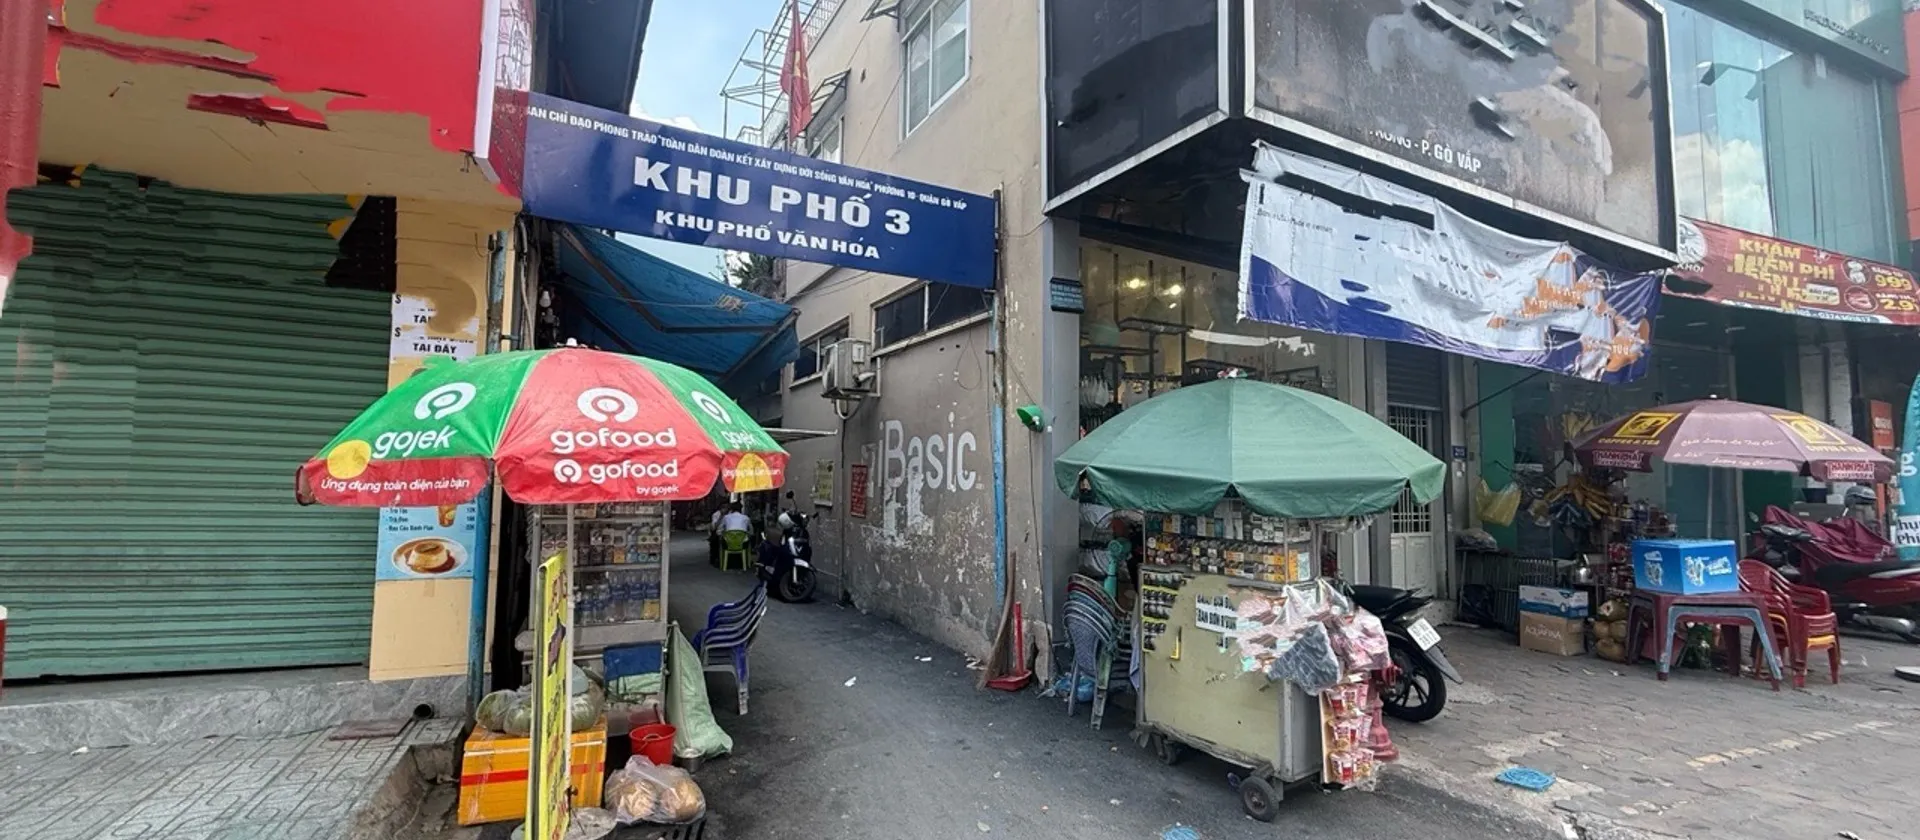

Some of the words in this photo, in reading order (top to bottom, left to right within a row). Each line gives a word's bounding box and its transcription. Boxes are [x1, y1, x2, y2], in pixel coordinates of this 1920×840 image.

[593, 121, 629, 138] PHONG
[631, 129, 657, 144] TRÀO
[736, 152, 753, 166] KẾT
[754, 157, 772, 170] XÂY
[1434, 142, 1453, 163] GÒ
[1457, 149, 1481, 173] VẤP
[634, 155, 750, 206] KHU
[769, 184, 872, 228] PHỐ
[884, 208, 911, 235] 3
[655, 209, 714, 232] KHU
[717, 219, 773, 241] PHỐ
[777, 229, 828, 250] VĂN
[831, 237, 880, 260] HÓA
[372, 425, 458, 459] gojek
[550, 427, 678, 454] gofood
[321, 476, 347, 493] Ứng
[348, 479, 381, 493] dụng
[409, 479, 433, 492] diện
[588, 458, 679, 485] gofood
[636, 485, 650, 497] by
[651, 484, 680, 496] gojek
